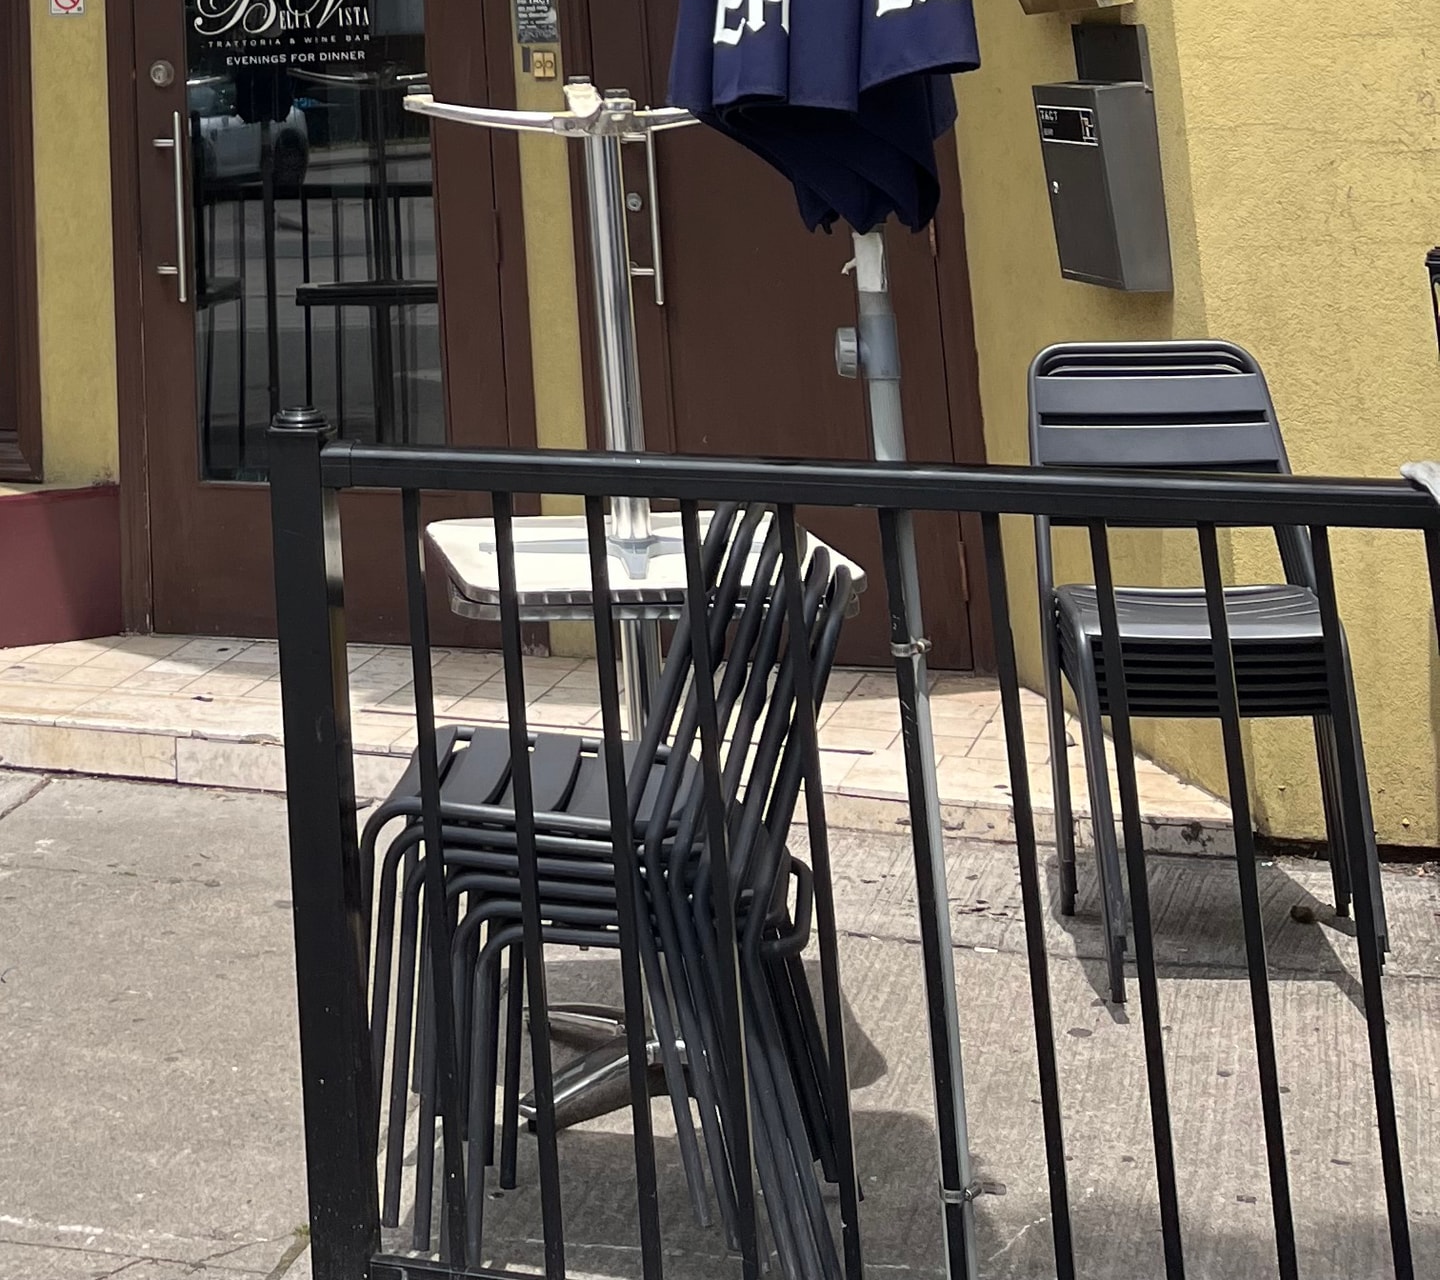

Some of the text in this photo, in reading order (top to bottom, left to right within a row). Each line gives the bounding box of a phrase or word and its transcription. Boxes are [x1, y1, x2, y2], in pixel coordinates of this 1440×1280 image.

[208, 39, 281, 49] TRATTORIA
[304, 35, 337, 44] WINE
[346, 33, 371, 42] BAR
[226, 50, 366, 66] EVENINGS FOR DINNER
